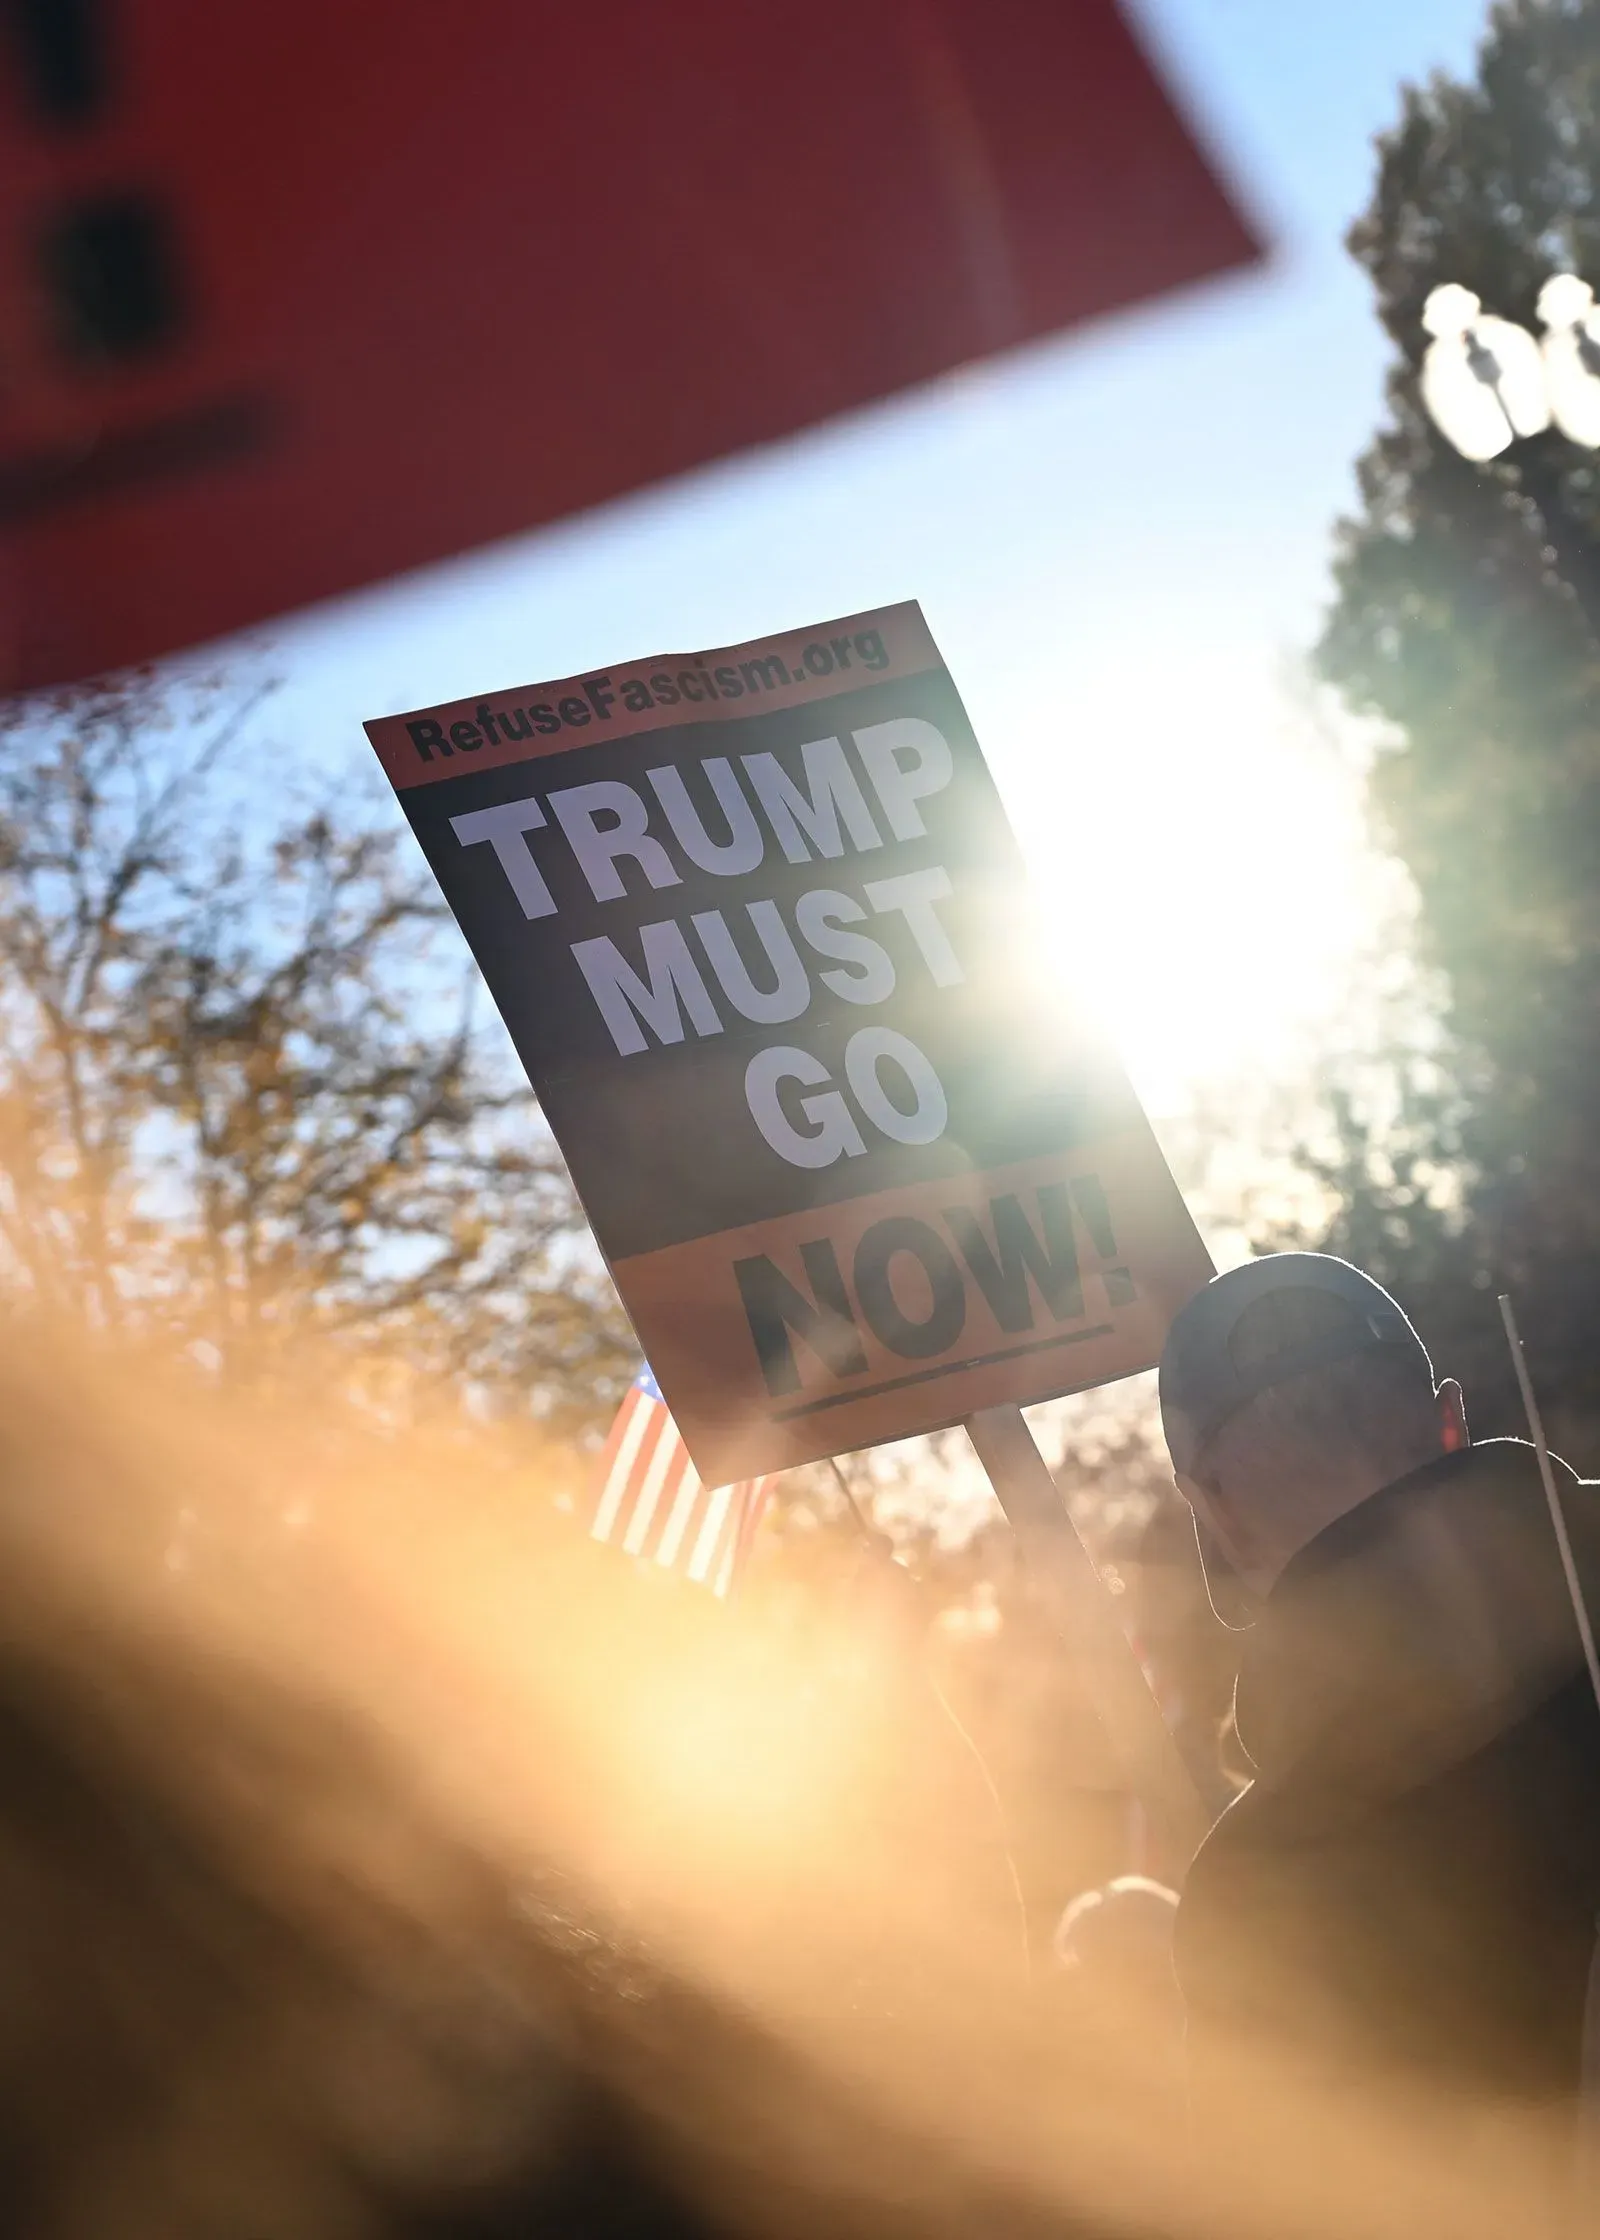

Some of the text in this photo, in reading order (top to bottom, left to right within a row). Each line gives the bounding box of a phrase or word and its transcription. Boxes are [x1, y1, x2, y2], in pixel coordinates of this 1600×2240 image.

[406, 628, 890, 763] RefuseFascism.org
[448, 717, 955, 920] TRUMP
[569, 866, 967, 1057] MUST
[744, 1026, 948, 1169] GO
[732, 1174, 1138, 1398] NOW!
